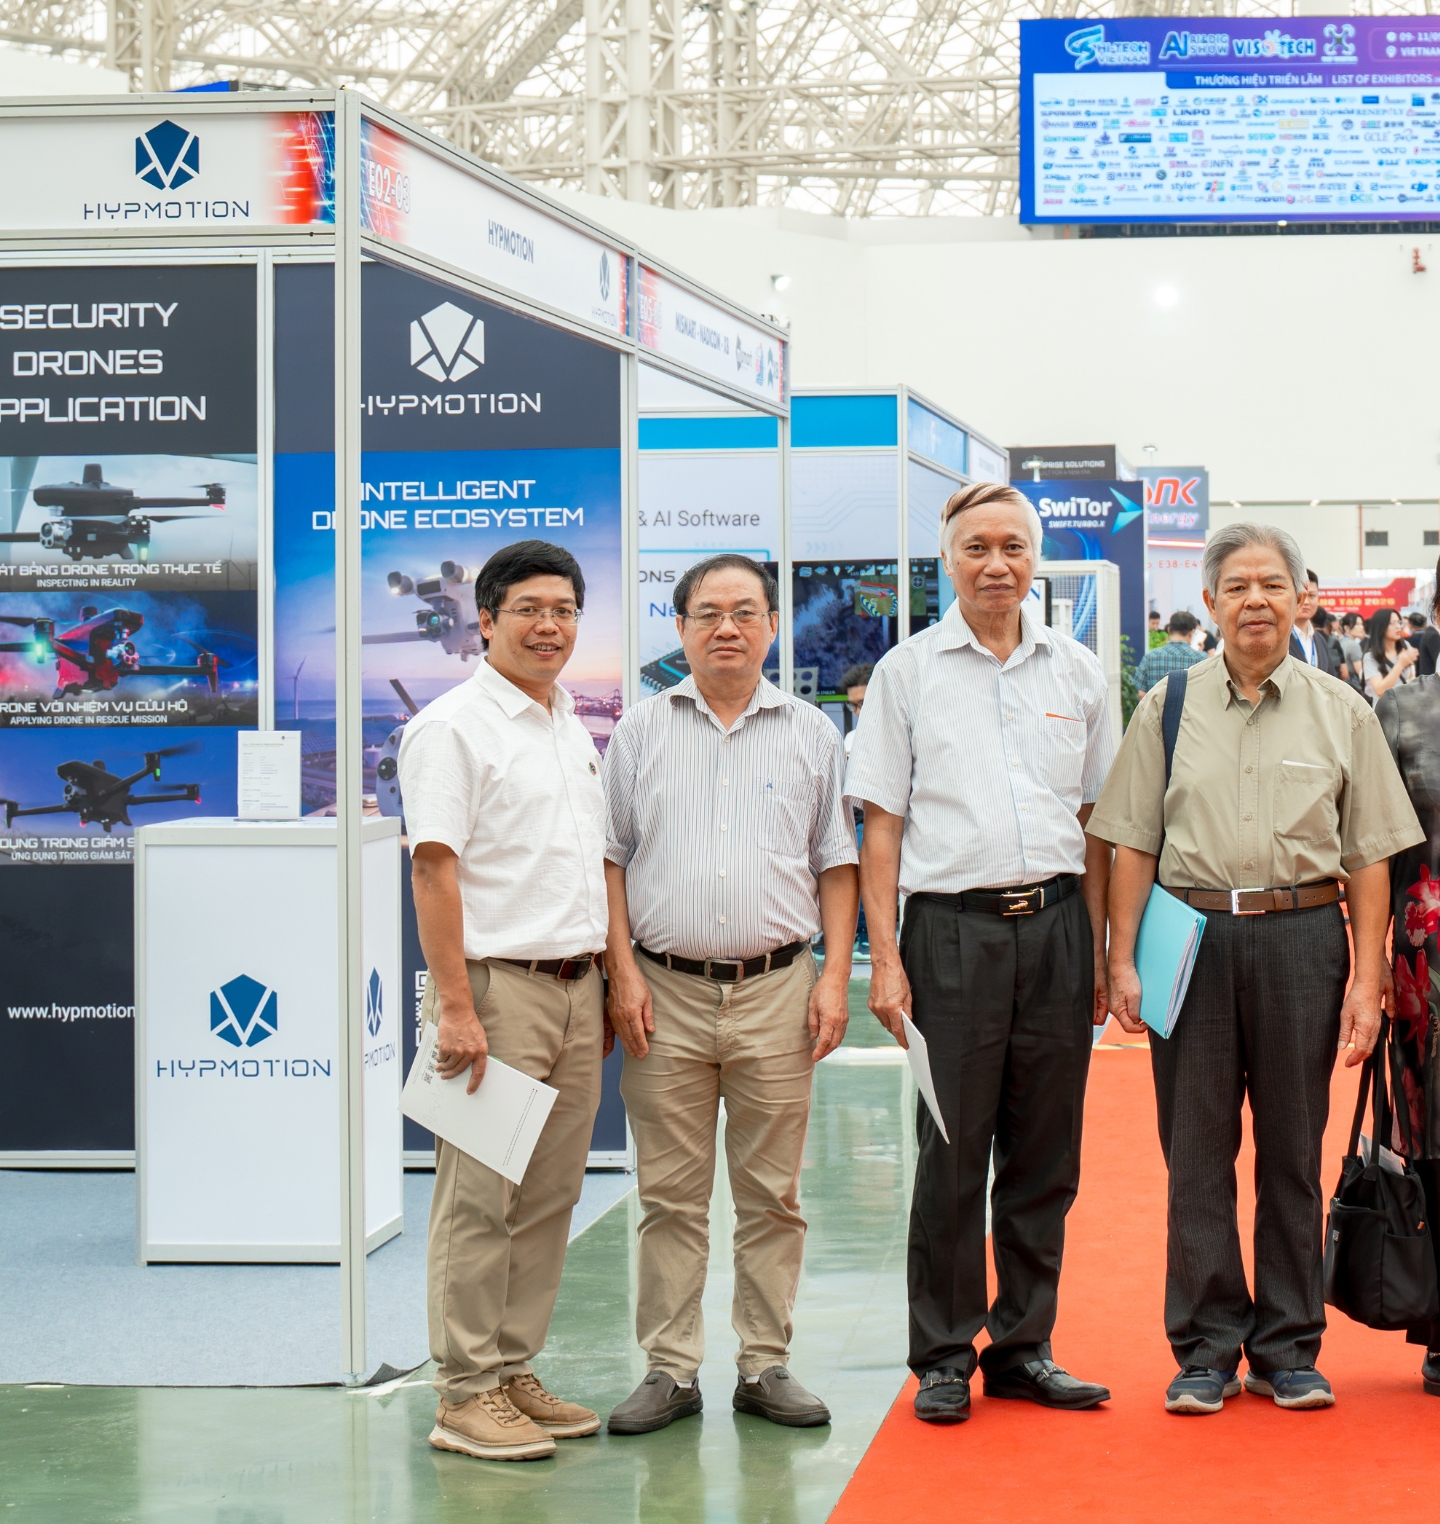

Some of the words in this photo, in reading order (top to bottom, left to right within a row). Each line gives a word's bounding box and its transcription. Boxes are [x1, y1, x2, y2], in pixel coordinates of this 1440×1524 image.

[1332, 74, 1353, 84] LIST
[1355, 74, 1369, 84] OF
[1372, 73, 1432, 84] EXHIBITORS
[368, 161, 411, 213] E02-03
[84, 201, 250, 219] HYPMOTION
[488, 219, 534, 264] HYPMOTION
[0, 302, 179, 329] SECURITY
[13, 350, 164, 377] DRONES
[1065, 460, 1105, 468] SOLUTIONS
[1039, 497, 1113, 517] SwiTor
[312, 509, 407, 530] DONE
[414, 507, 584, 529] ECOSYSTEM
[678, 510, 760, 527] Software
[1148, 512, 1199, 528] nergy
[61, 564, 109, 575] DRONE
[111, 563, 160, 575] TRONG
[37, 578, 88, 588] INSPECTING
[90, 578, 99, 587] IN
[101, 577, 136, 587] REALITY
[111, 701, 134, 714] VỤ
[167, 698, 188, 713] HỘ
[10, 715, 52, 725] APPLYING
[54, 715, 83, 724] DRONE
[85, 715, 94, 724] IN
[96, 715, 130, 724] RESCUE
[131, 714, 168, 724] MISSION
[41, 837, 88, 849] TRONG
[32, 851, 57, 861] DỤNG
[59, 851, 88, 860] TRONG
[90, 850, 113, 860] GIÁM
[114, 849, 131, 860] SÁT
[157, 1059, 331, 1077] HYPMOTION
